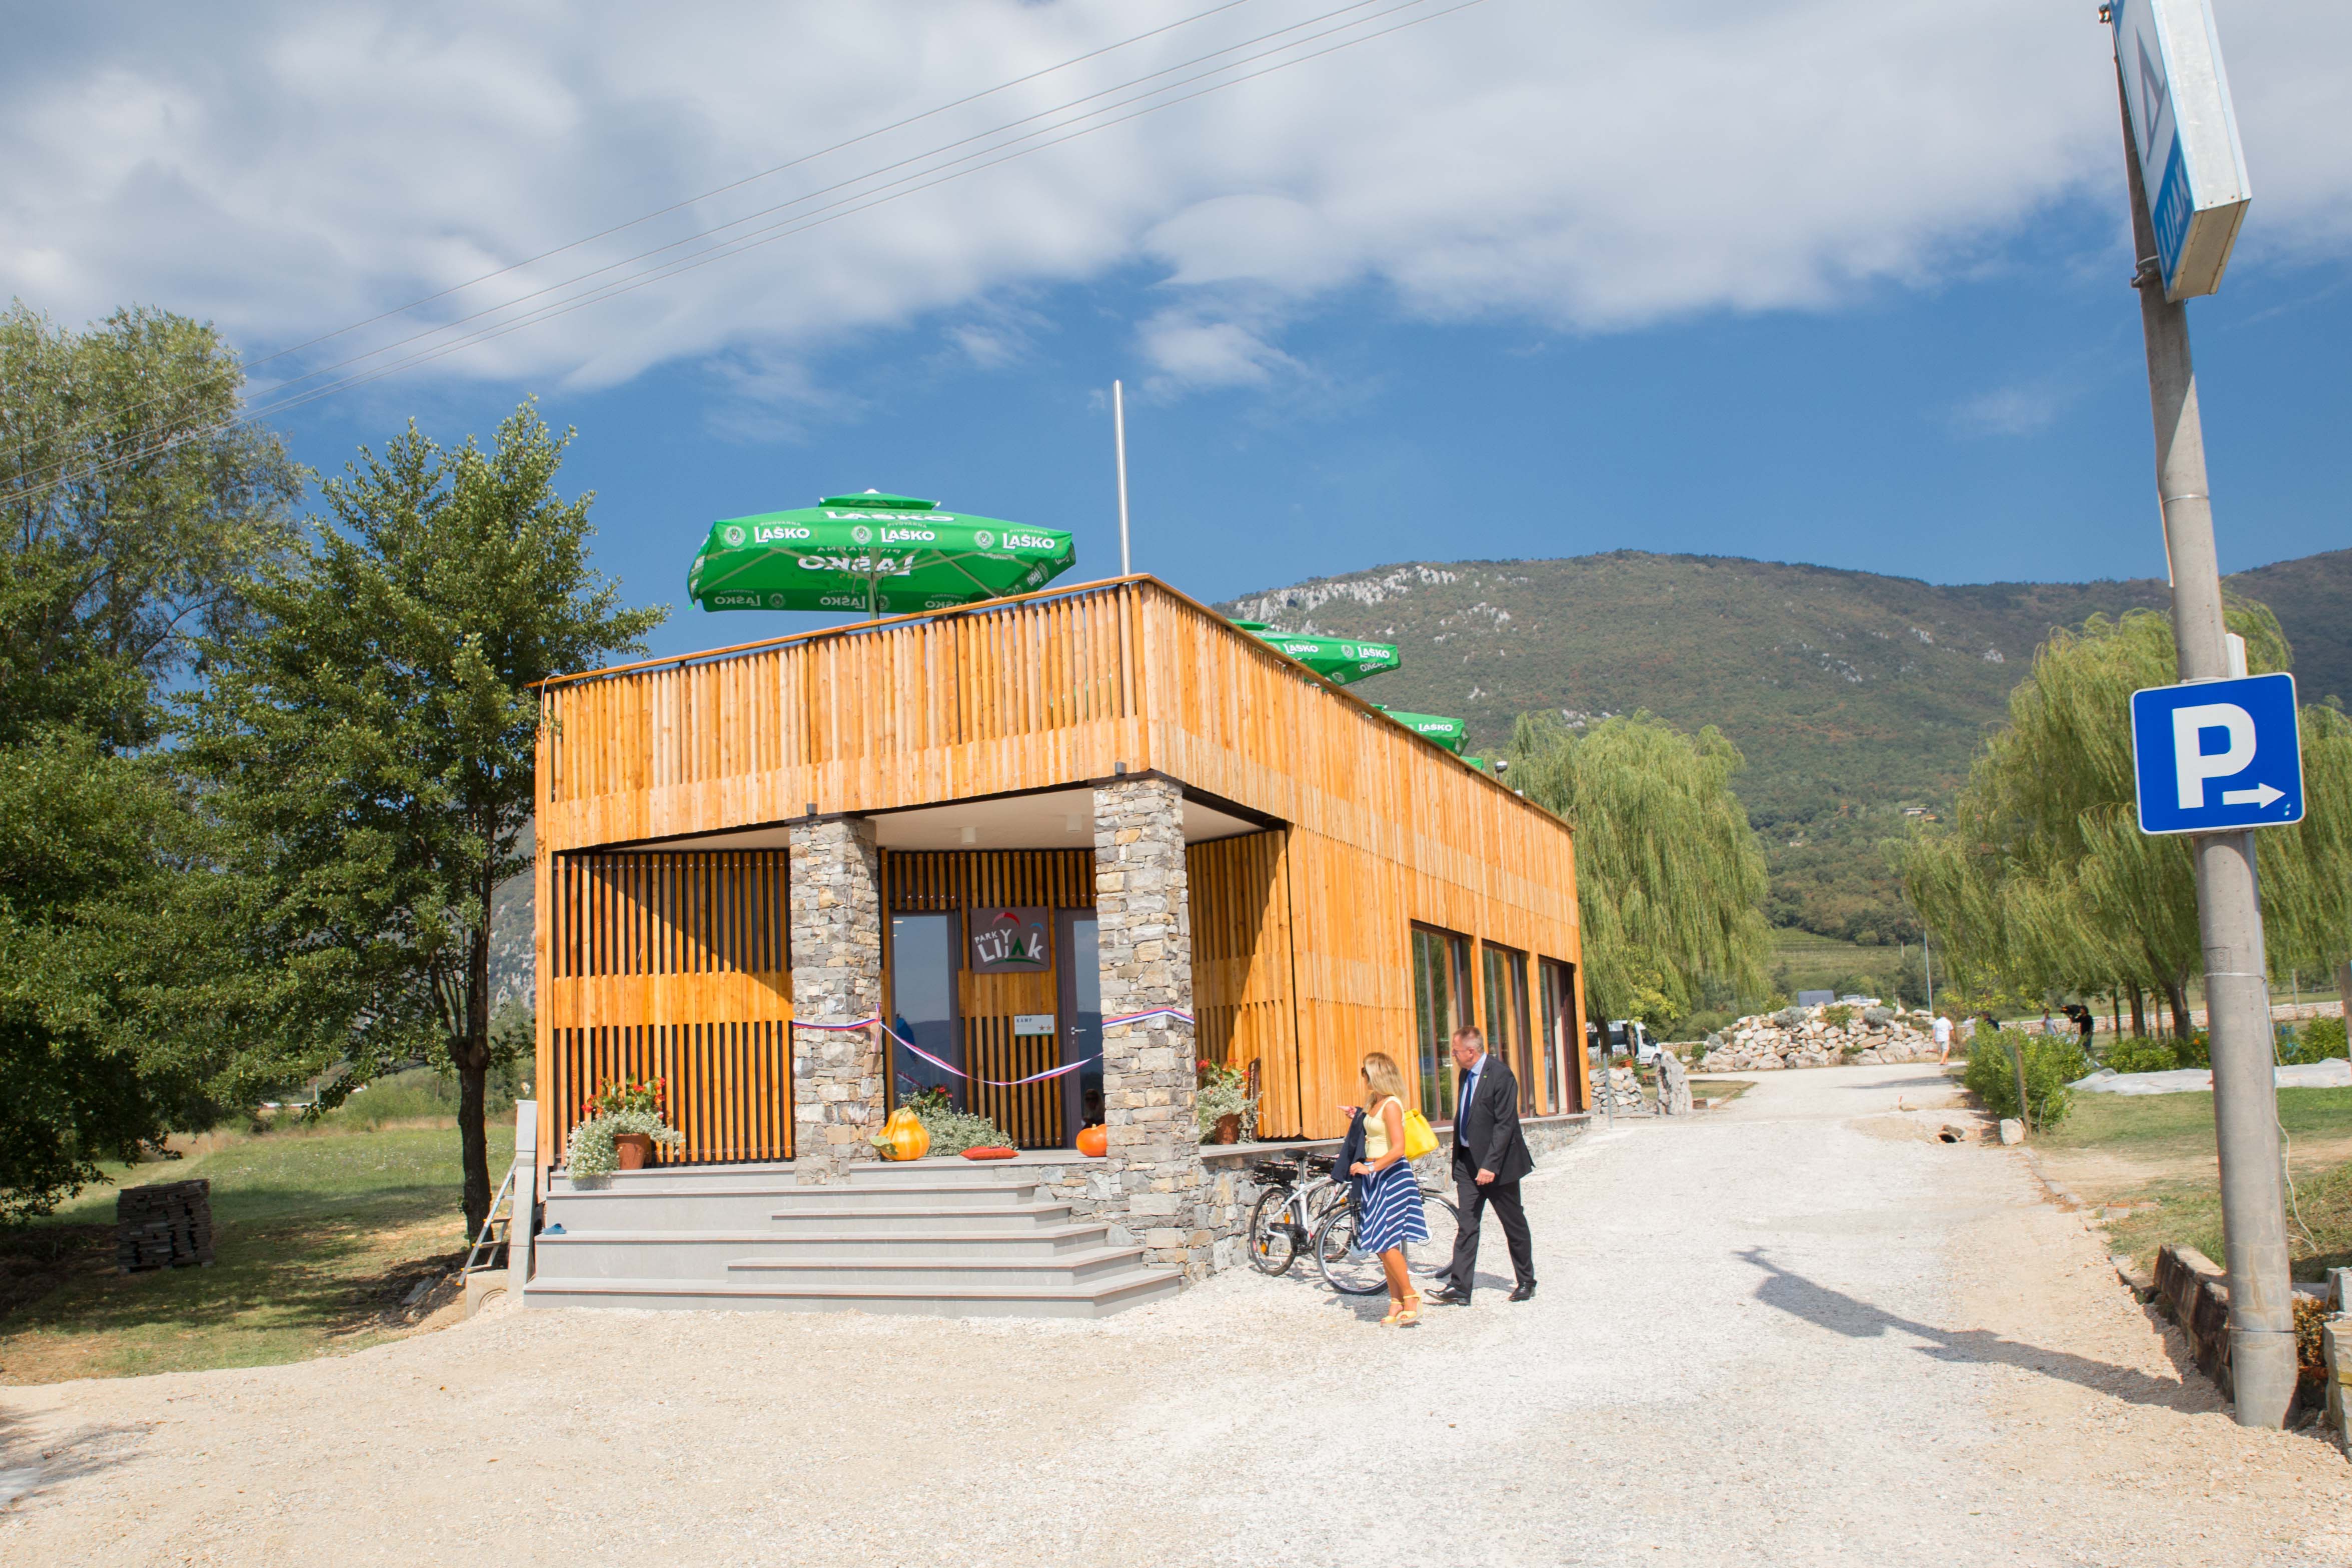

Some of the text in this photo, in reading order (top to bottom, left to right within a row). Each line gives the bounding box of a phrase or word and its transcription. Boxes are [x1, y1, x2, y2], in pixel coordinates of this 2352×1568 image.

[753, 526, 810, 543] LAŠKO
[881, 528, 935, 543] LAŠKO
[1003, 533, 1055, 549] LAŠKO
[2172, 703, 2256, 809] P
[974, 931, 998, 944] PARK
